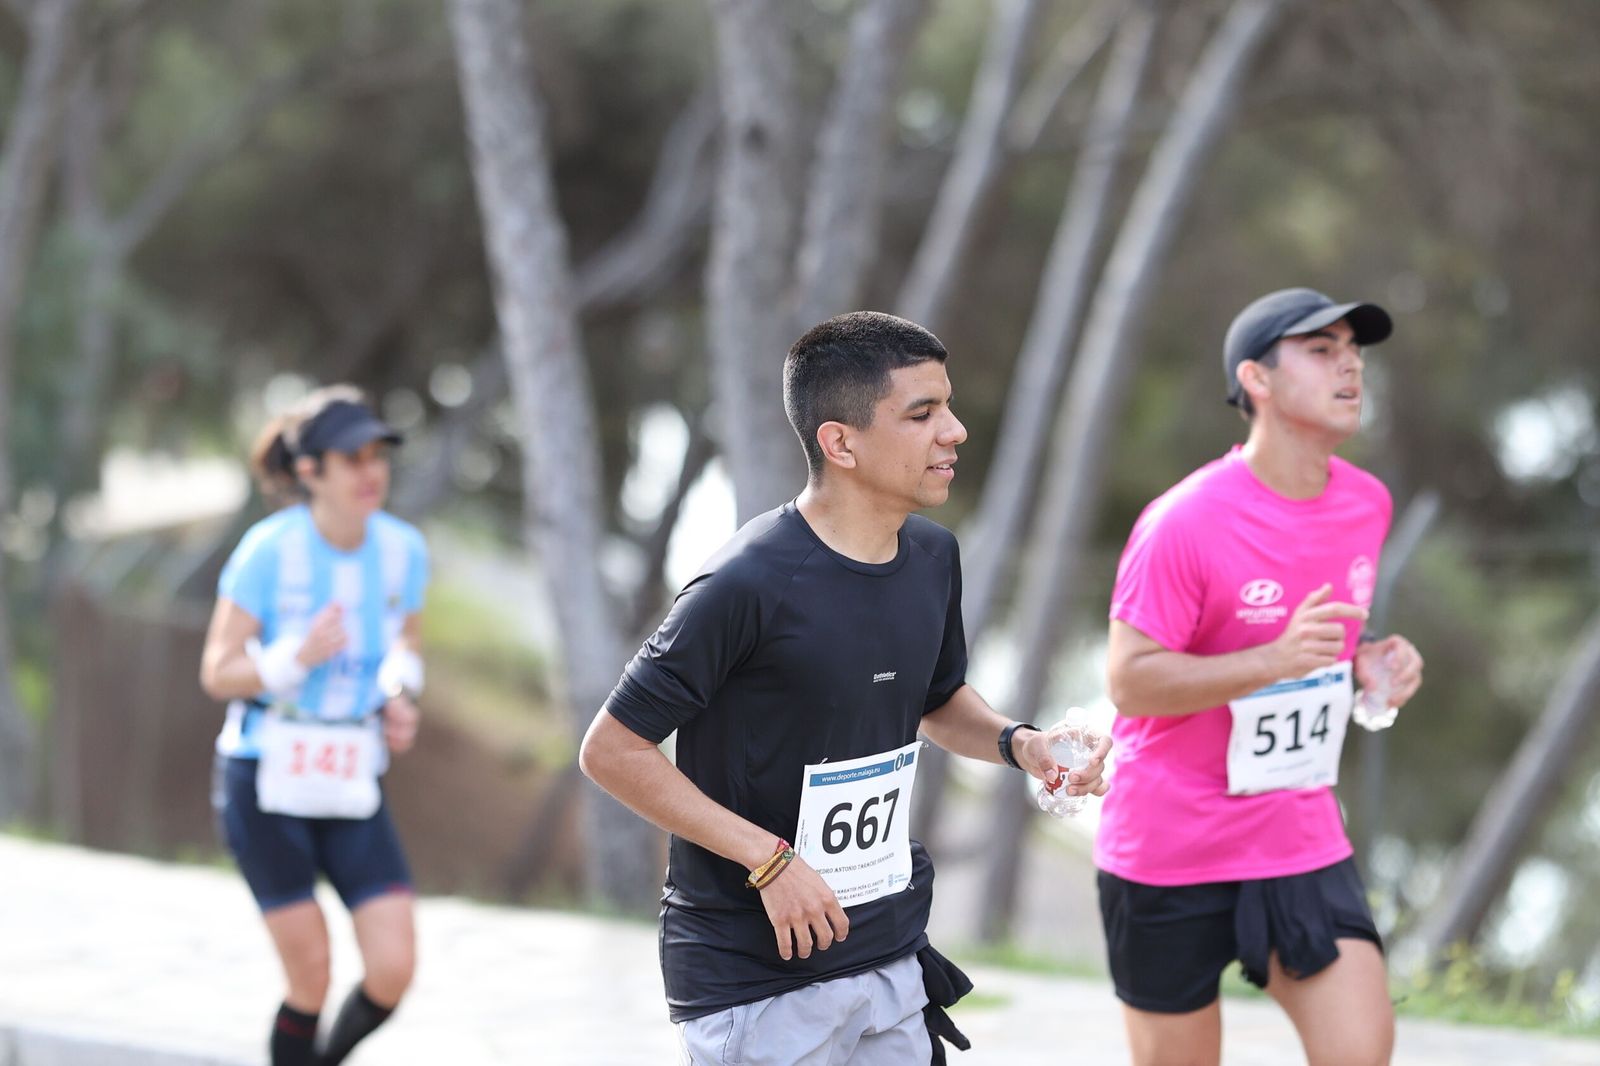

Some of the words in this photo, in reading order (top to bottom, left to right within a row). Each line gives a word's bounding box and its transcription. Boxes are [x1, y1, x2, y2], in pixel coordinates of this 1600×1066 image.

[1253, 703, 1330, 756] 514
[821, 767, 881, 783] www.deporte.malaga.eu
[821, 787, 900, 855] 667
